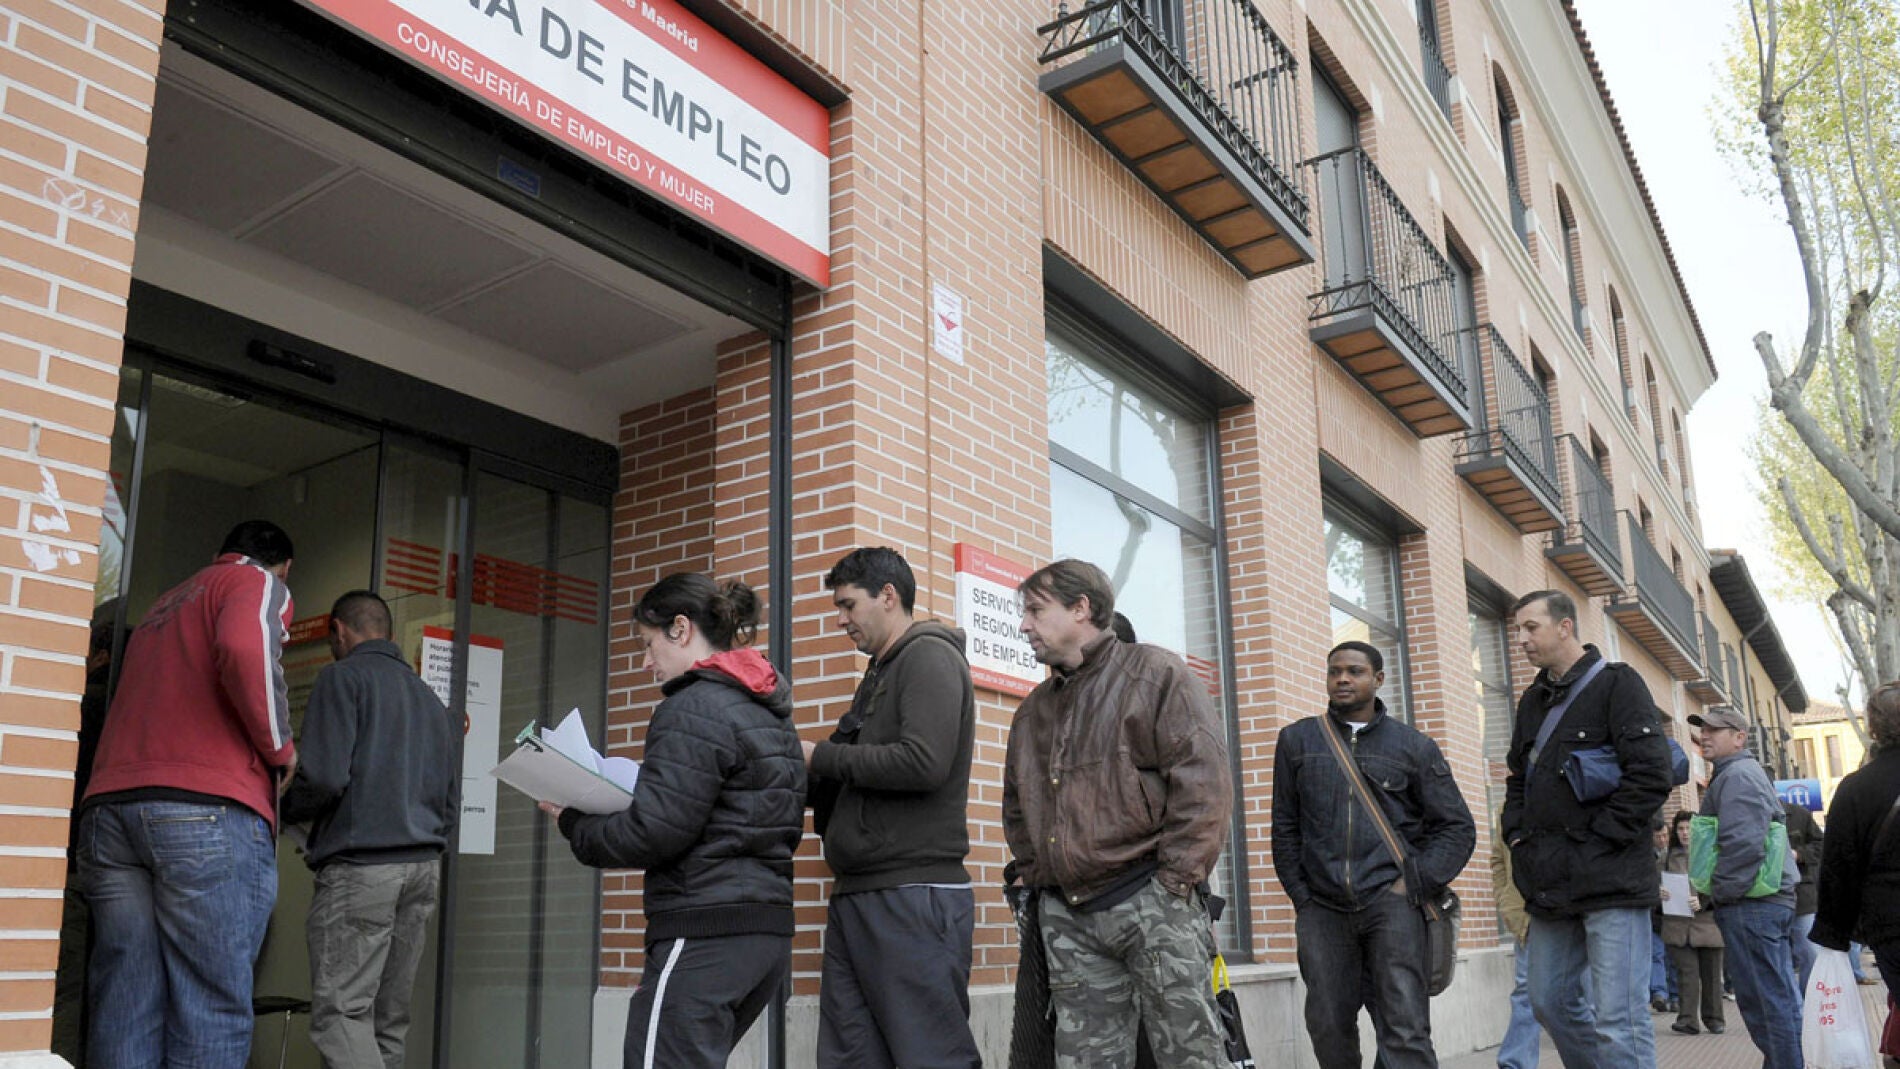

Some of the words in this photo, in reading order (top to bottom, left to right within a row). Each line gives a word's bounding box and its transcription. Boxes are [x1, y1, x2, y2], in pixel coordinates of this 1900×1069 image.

[642, 2, 698, 52] Madrid
[397, 22, 531, 112] CONSEJERÍA
[536, 99, 563, 129] DE
[567, 116, 641, 172] EMPLEO
[644, 160, 657, 180] Y
[659, 169, 715, 215] MUJER
[540, 6, 605, 85] DE
[622, 58, 791, 195] EMPLEO
[972, 587, 1024, 619] SERVICO
[973, 637, 989, 657] DE
[992, 643, 1038, 669] EMPLEO
